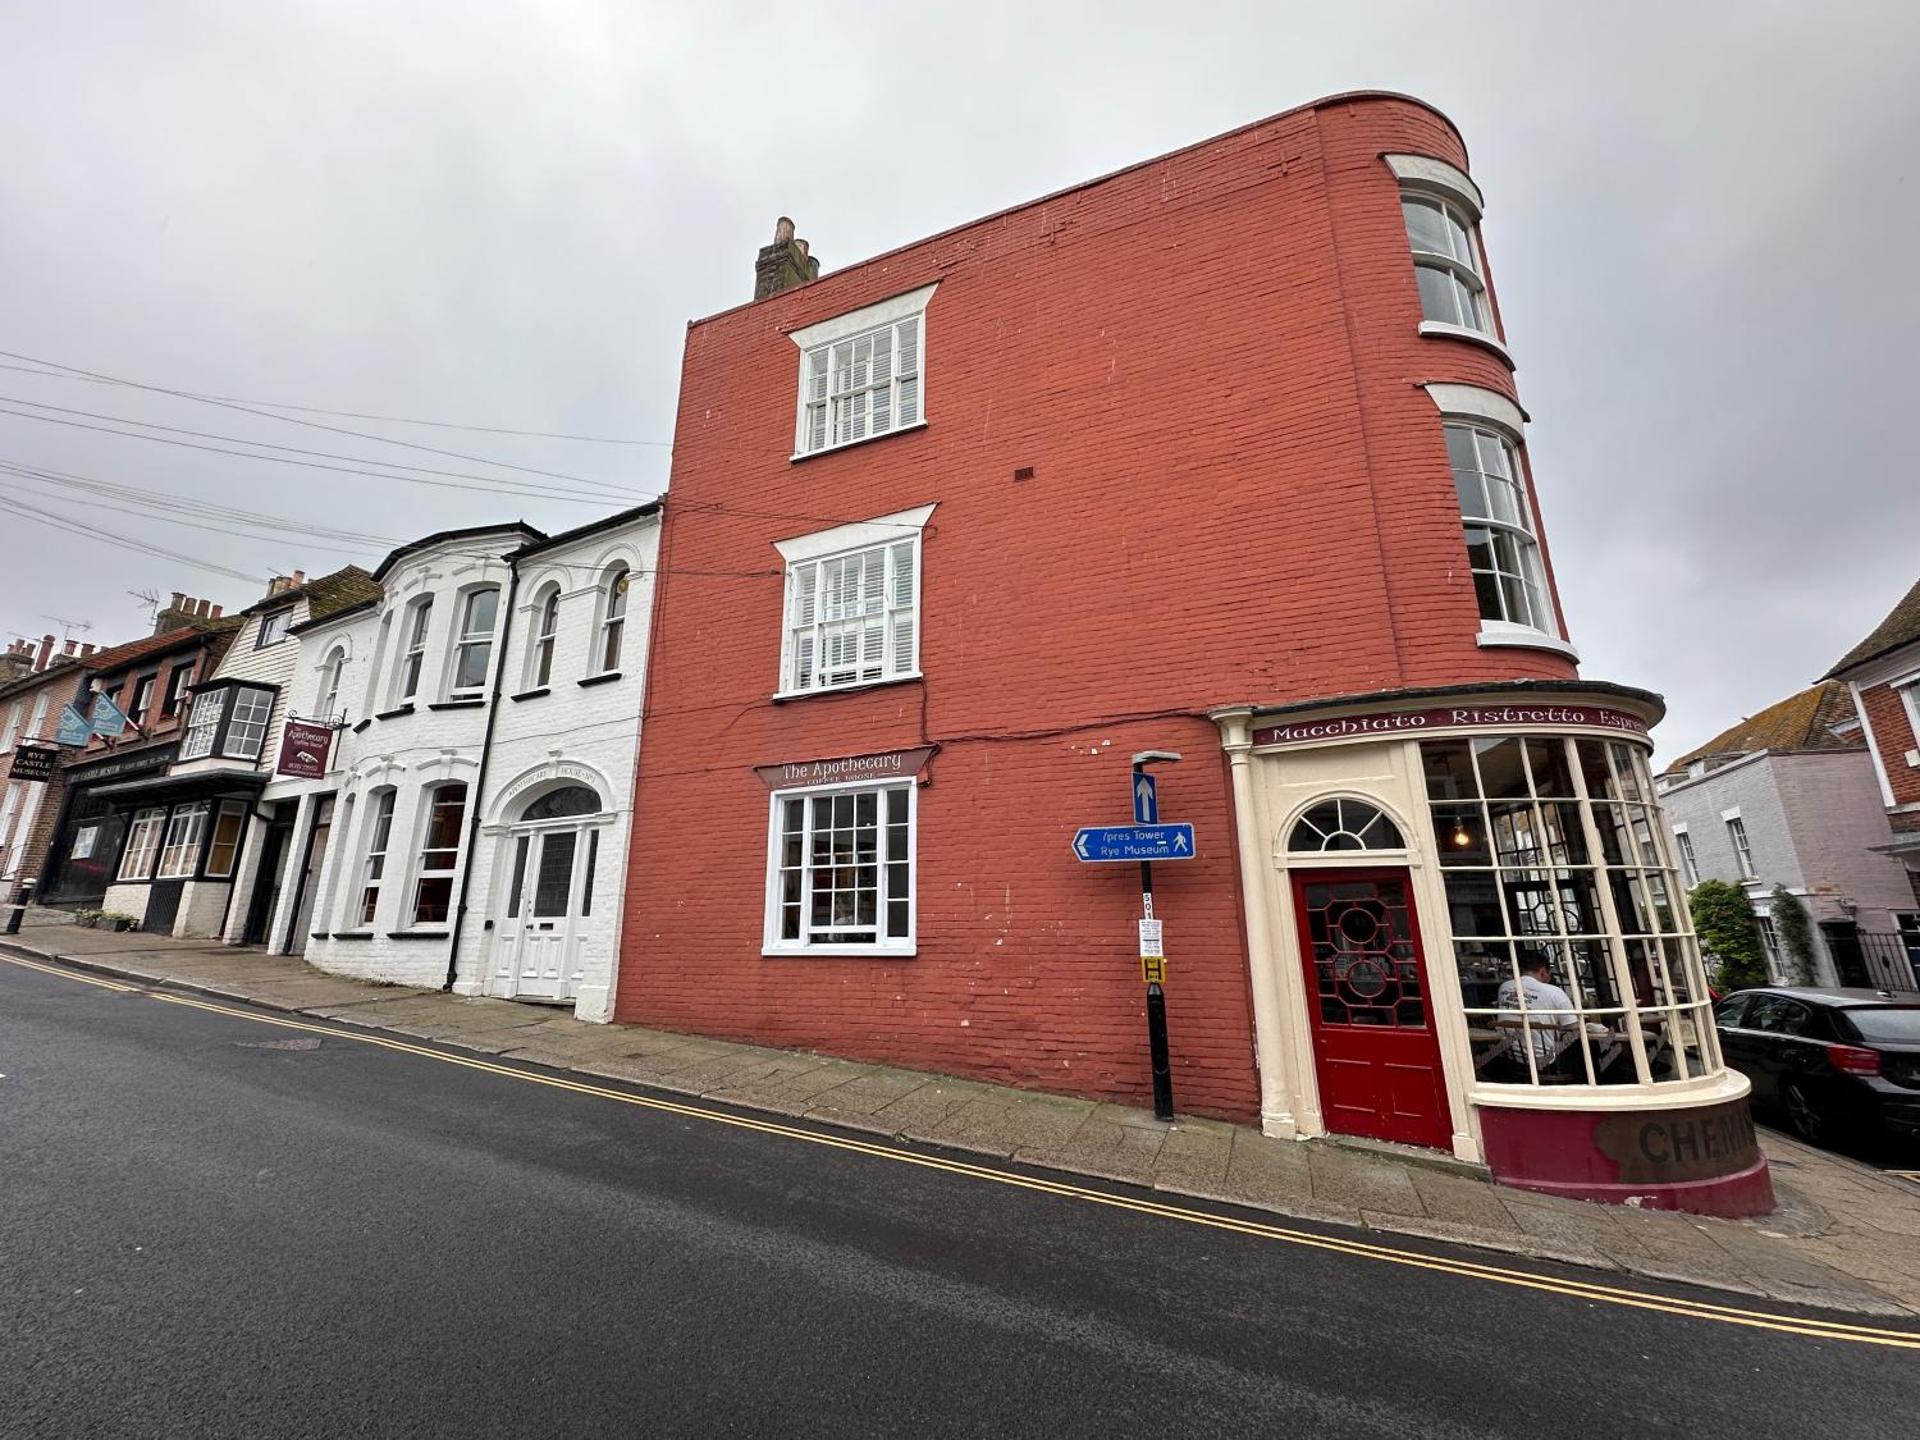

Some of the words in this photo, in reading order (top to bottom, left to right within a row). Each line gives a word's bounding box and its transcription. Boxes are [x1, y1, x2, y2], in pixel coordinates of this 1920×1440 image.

[1273, 715, 1426, 742] Macchiato
[1451, 707, 1585, 724] Ristretto
[27, 752, 46, 760] RYE
[16, 758, 51, 769] CASTLE
[782, 764, 808, 780] The
[812, 754, 902, 779] Apothecary
[12, 767, 50, 777] MUSEUM
[1133, 830, 1165, 841] Tower
[1100, 845, 1120, 857] Rye
[1124, 844, 1169, 855] Museum
[1144, 958, 1162, 981] H
